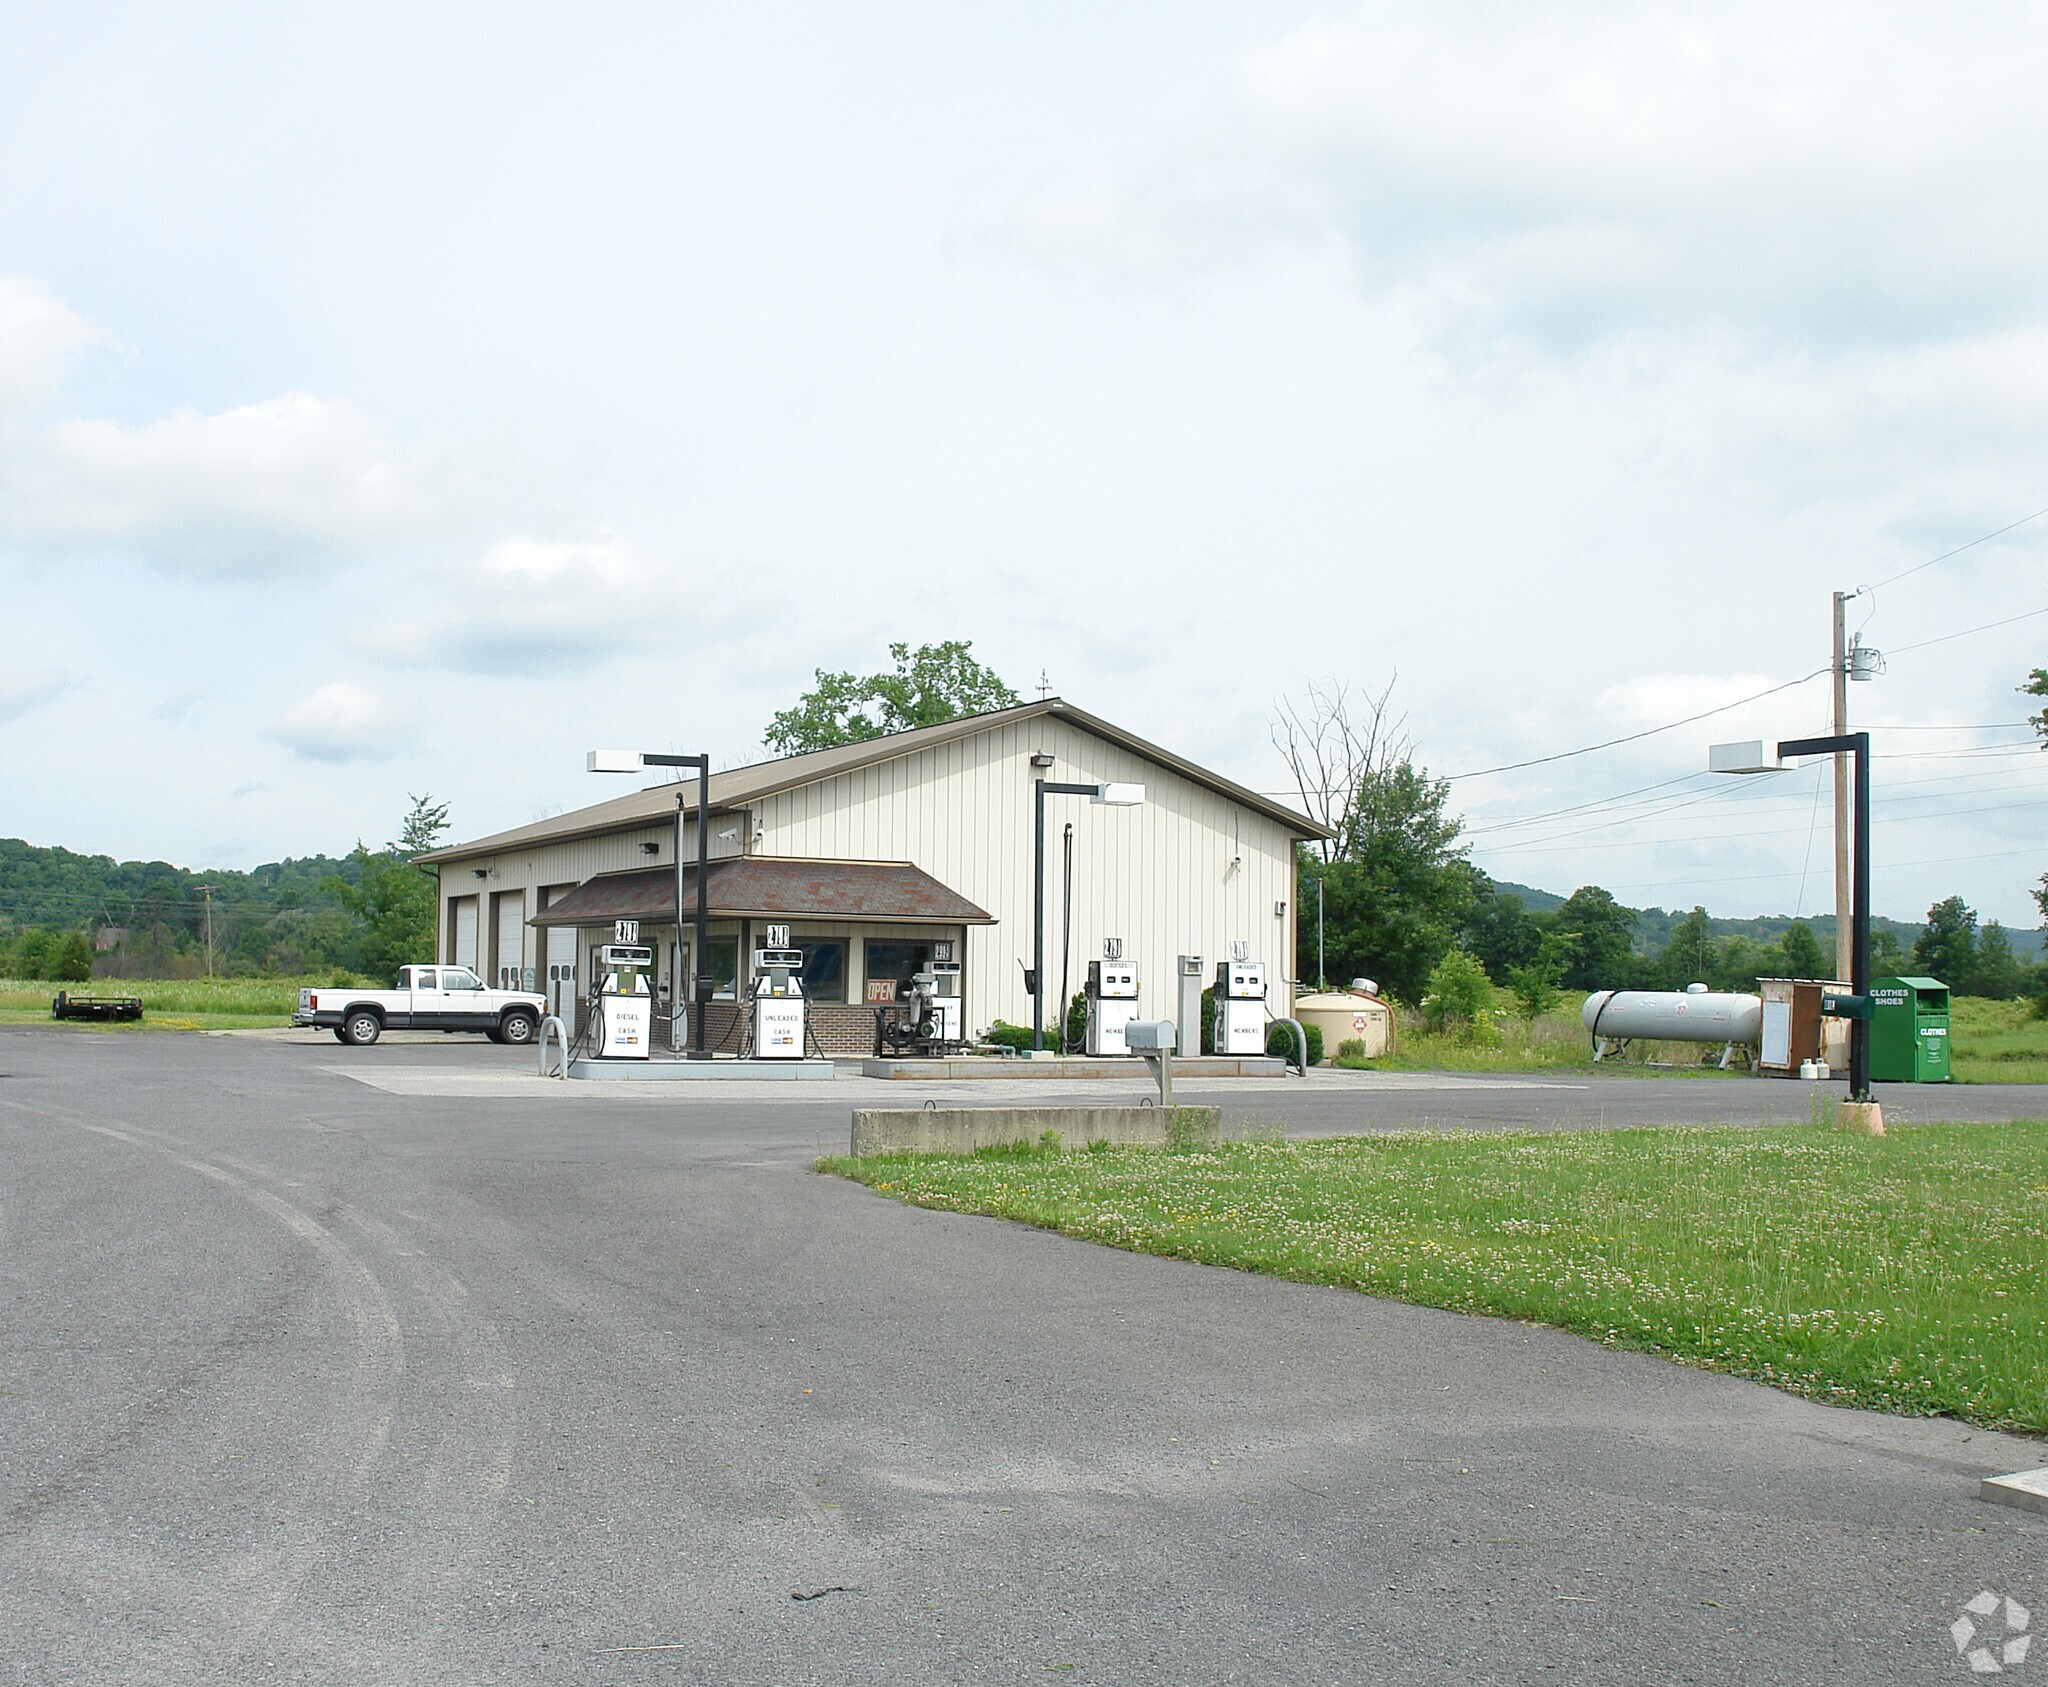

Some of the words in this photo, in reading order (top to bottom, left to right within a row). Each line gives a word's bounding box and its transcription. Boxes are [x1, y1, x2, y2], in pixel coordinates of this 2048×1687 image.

[867, 982, 895, 1001] OPEN
[1869, 989, 1909, 997] CLOTHES
[1875, 998, 1904, 1006] SHOES
[1920, 1028, 1947, 1036] CLOTHES
